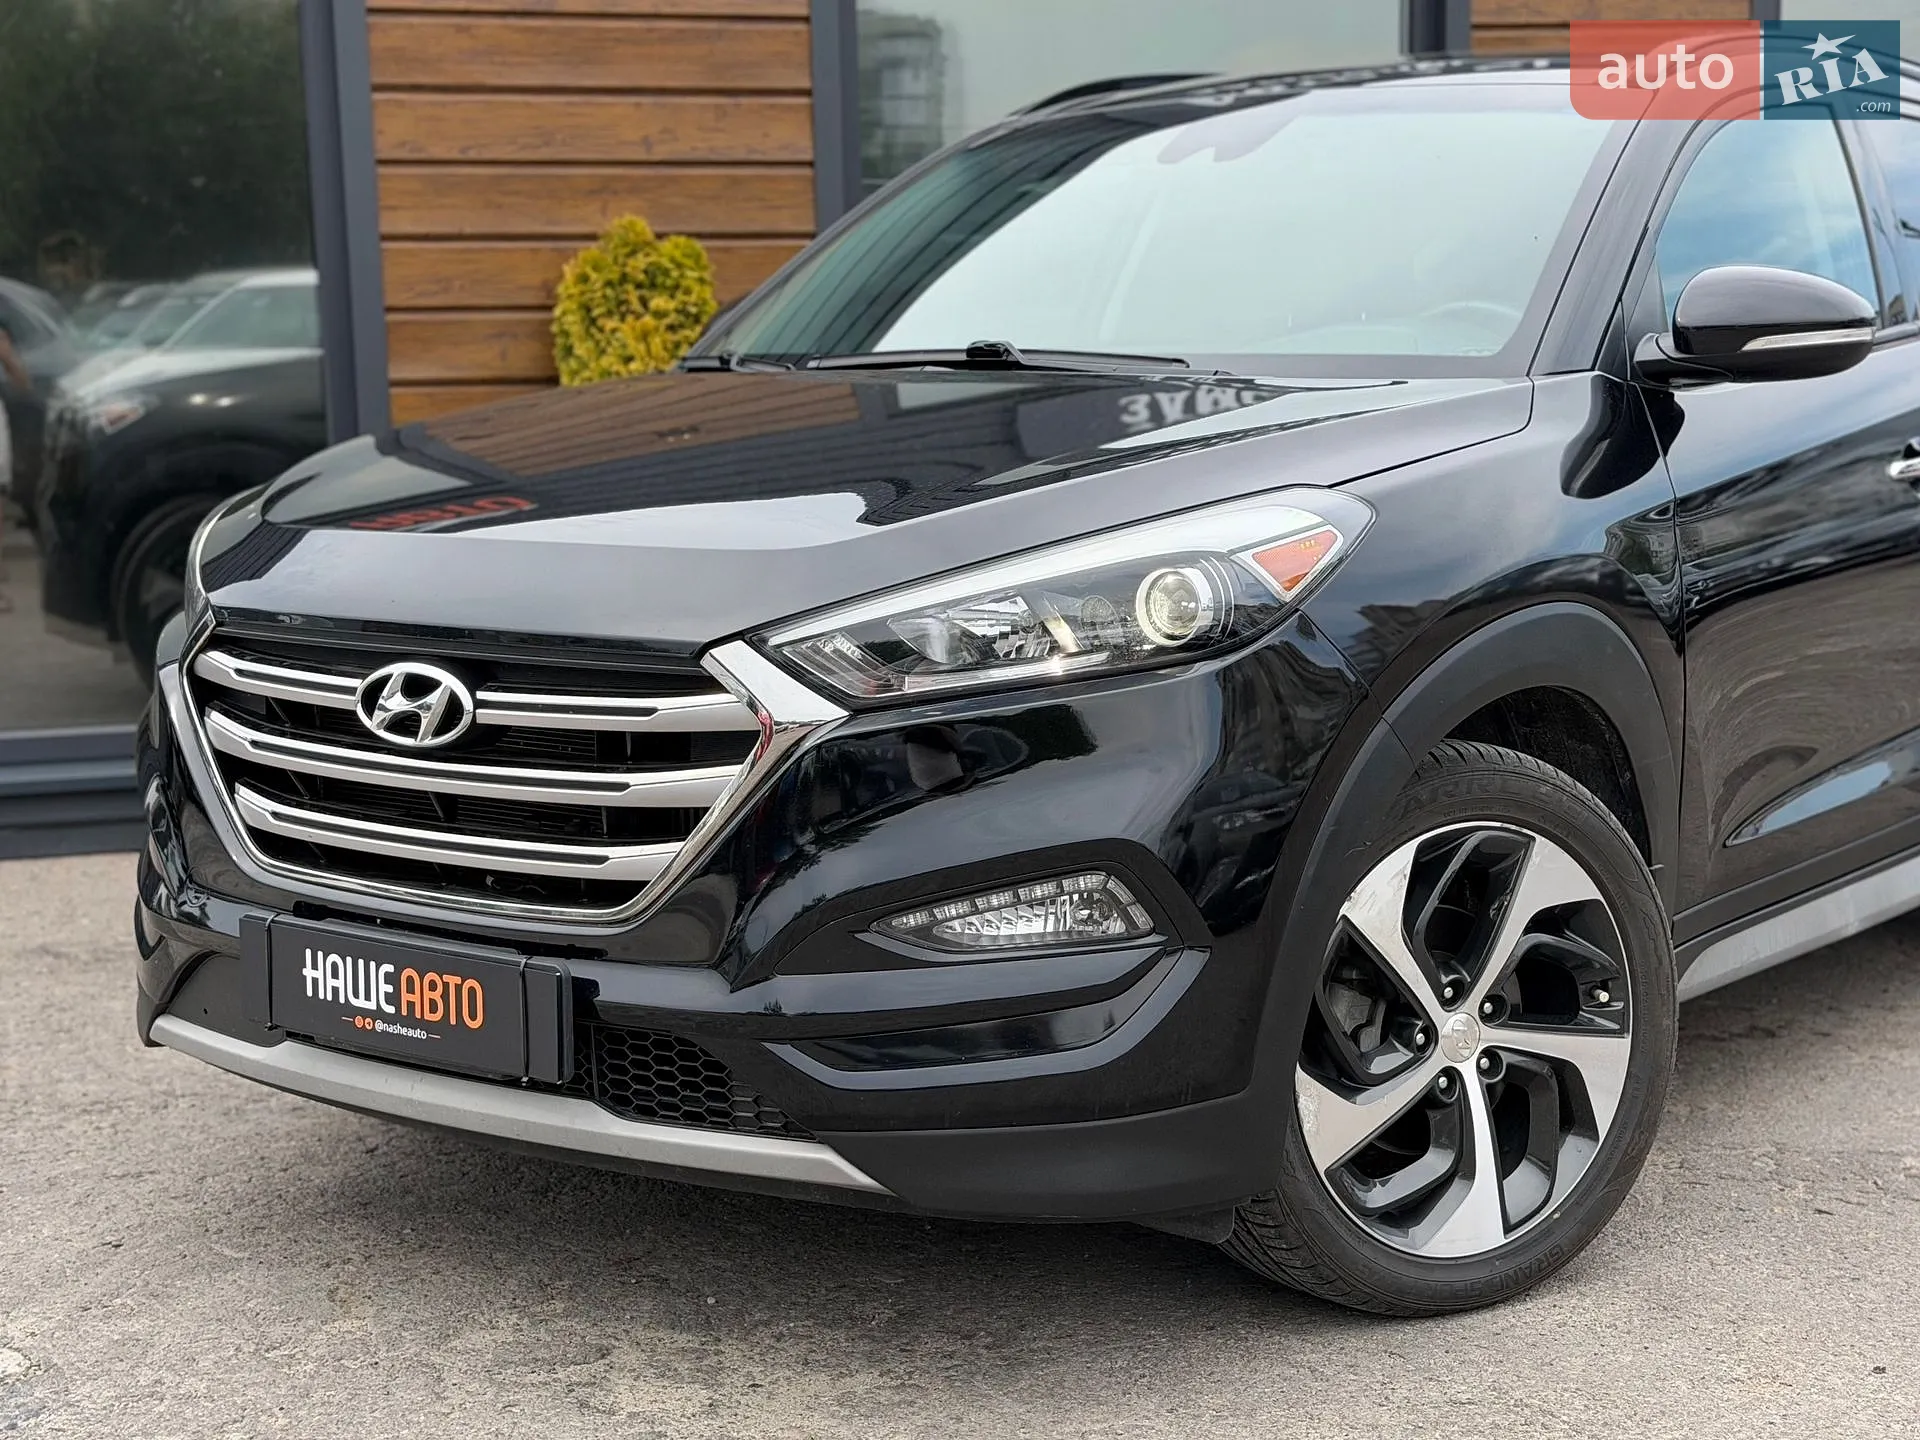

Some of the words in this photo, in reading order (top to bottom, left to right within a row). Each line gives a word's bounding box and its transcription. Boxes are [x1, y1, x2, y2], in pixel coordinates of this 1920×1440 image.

[302, 948, 396, 1014] НАШЕ
[401, 968, 484, 1029] АВТО
[375, 1019, 428, 1040] @nasheauto
